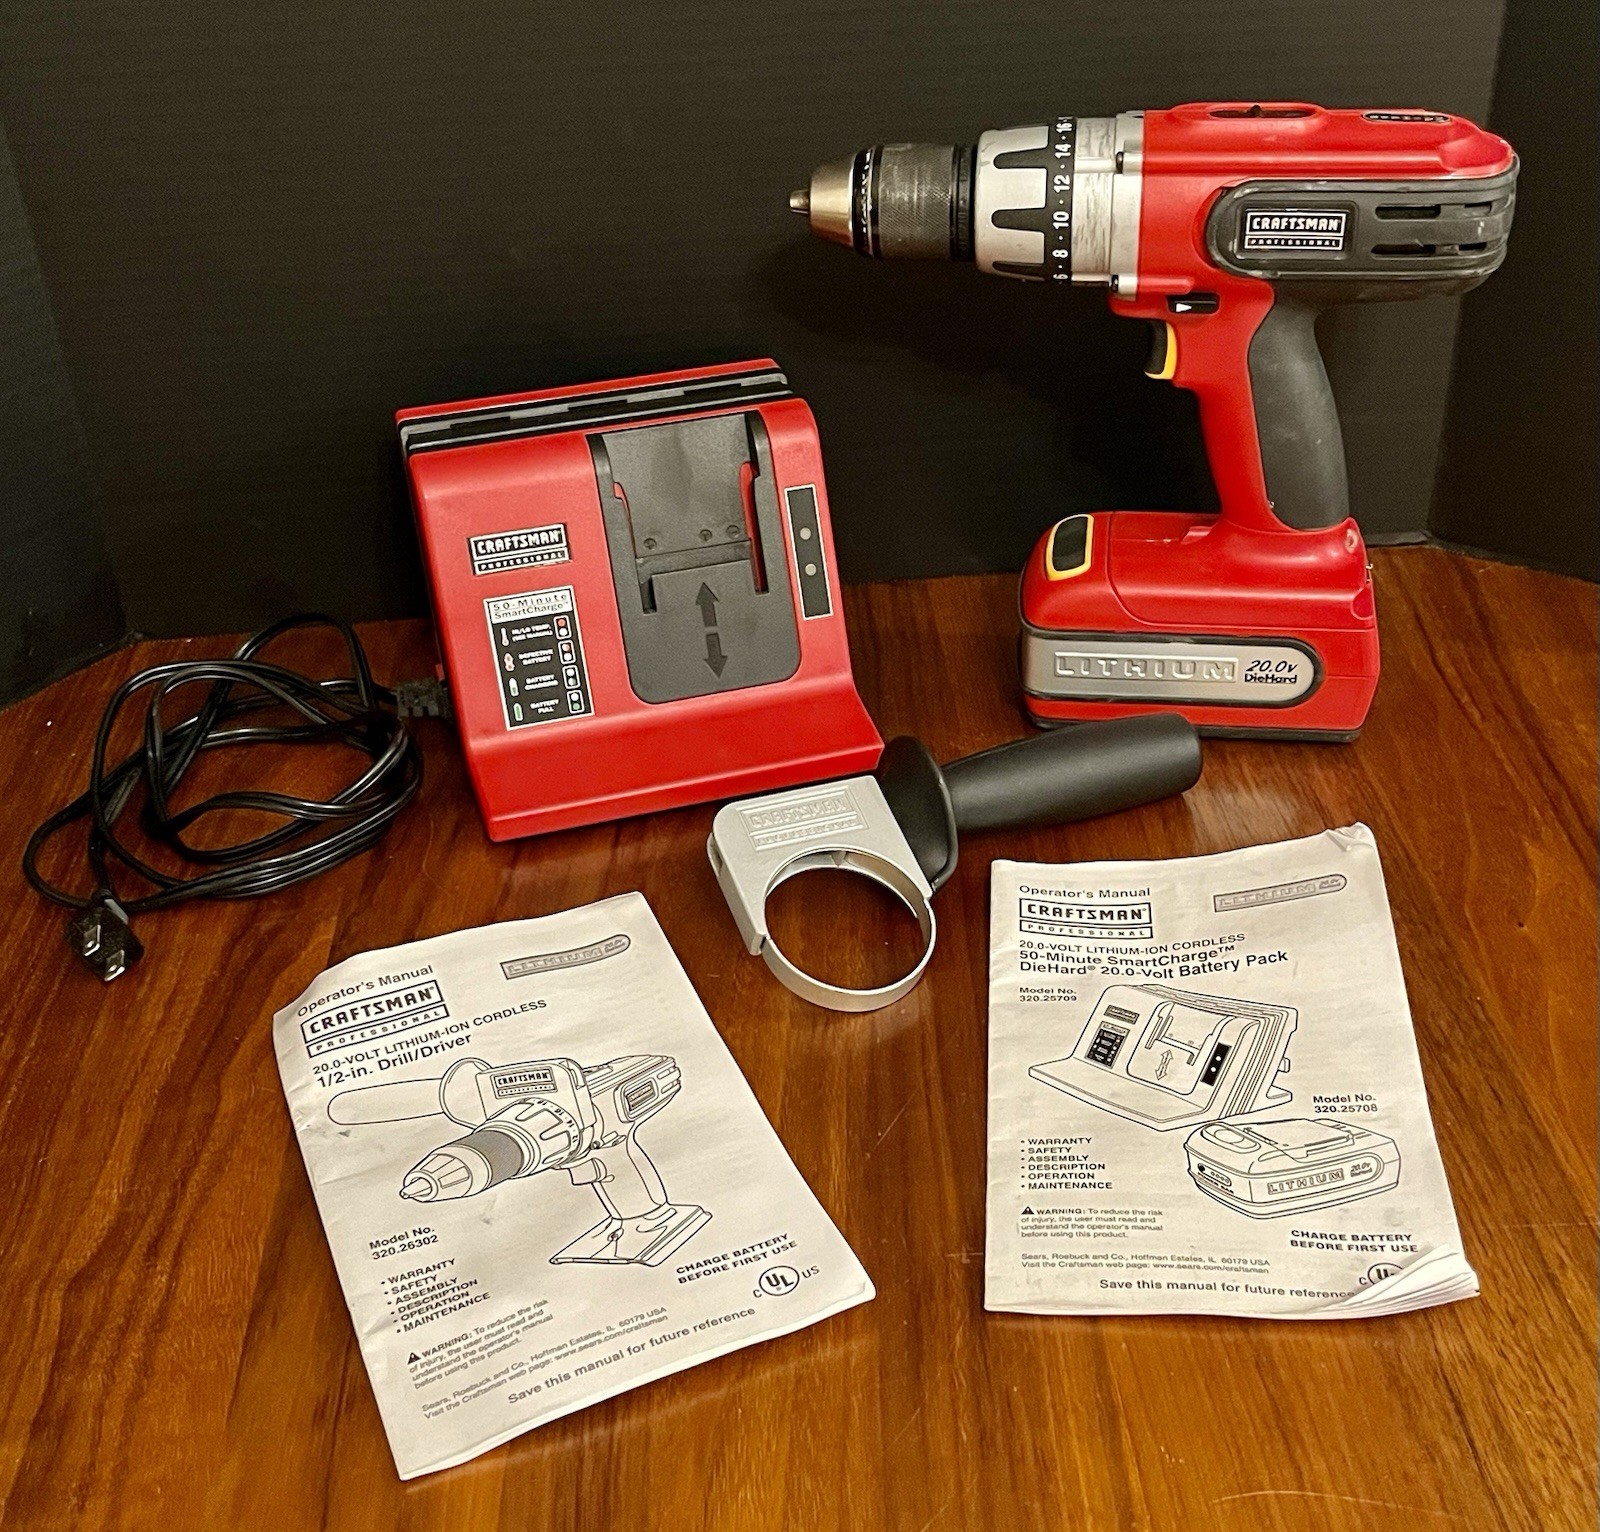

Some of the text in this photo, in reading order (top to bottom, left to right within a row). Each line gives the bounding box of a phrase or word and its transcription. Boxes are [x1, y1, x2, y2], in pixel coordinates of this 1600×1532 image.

[1056, 122, 1072, 133] 16
[1055, 144, 1072, 158] 14
[1054, 175, 1070, 193] 12
[1053, 211, 1069, 229] 10
[1052, 249, 1068, 258] 8
[481, 552, 563, 571] PROFESSIONAL
[493, 593, 568, 611] 50-Minute
[1056, 656, 1235, 680] LITHIUM
[1245, 674, 1298, 684] DieHard
[1019, 885, 1150, 898] Operator's Manual
[1028, 924, 1144, 936] PROFESSIONAL
[1019, 933, 1245, 955] 20.0-VOLT LITHIUM-ION CORDLESS
[1020, 951, 1102, 964] 50-Minute
[1101, 966, 1174, 978] 20.0-Volt
[1179, 959, 1239, 976] Battery
[1246, 951, 1288, 966] Pack
[298, 965, 433, 1016] Operator's Manual
[1019, 987, 1054, 996] Model
[312, 999, 547, 1075] 20.0-VOLT LITHIUM-ION CORDLESS
[316, 1012, 440, 1050] PROFESSIONAL
[317, 1034, 471, 1087] 1/2-in. Drill/Driver
[1313, 1094, 1376, 1103] Model No.
[1314, 1103, 1378, 1113] 320.25708
[1270, 1169, 1342, 1193] LITHIUM
[1058, 1216, 1072, 1224] the
[1071, 1223, 1085, 1232] the
[369, 1227, 435, 1249] Model No.
[1291, 1230, 1346, 1240] CHARGE
[372, 1234, 438, 1260] 320.26302
[676, 1233, 787, 1274] CHARGE BATTERY
[1290, 1239, 1343, 1251] BEFORE
[678, 1241, 796, 1284] BEFORE FIRST USE
[1052, 1253, 1090, 1262] Roebuck
[1170, 1254, 1205, 1263] Estates,
[387, 1258, 455, 1284] WARRANTY
[766, 1273, 794, 1288] UL
[802, 1266, 820, 1279] US
[391, 1274, 437, 1294] SAFETY
[395, 1277, 459, 1305] ASSEMBLY
[1100, 1279, 1132, 1289] Save
[1137, 1280, 1162, 1289] this
[1166, 1282, 1216, 1290] manual
[1221, 1282, 1240, 1292] for
[1244, 1284, 1285, 1295] future
[398, 1278, 478, 1314] DESCRIPTION
[400, 1290, 472, 1321] OPERATION
[403, 1292, 490, 1332] MAINTENANCE
[508, 1308, 755, 1404] Save this manual for future reference
